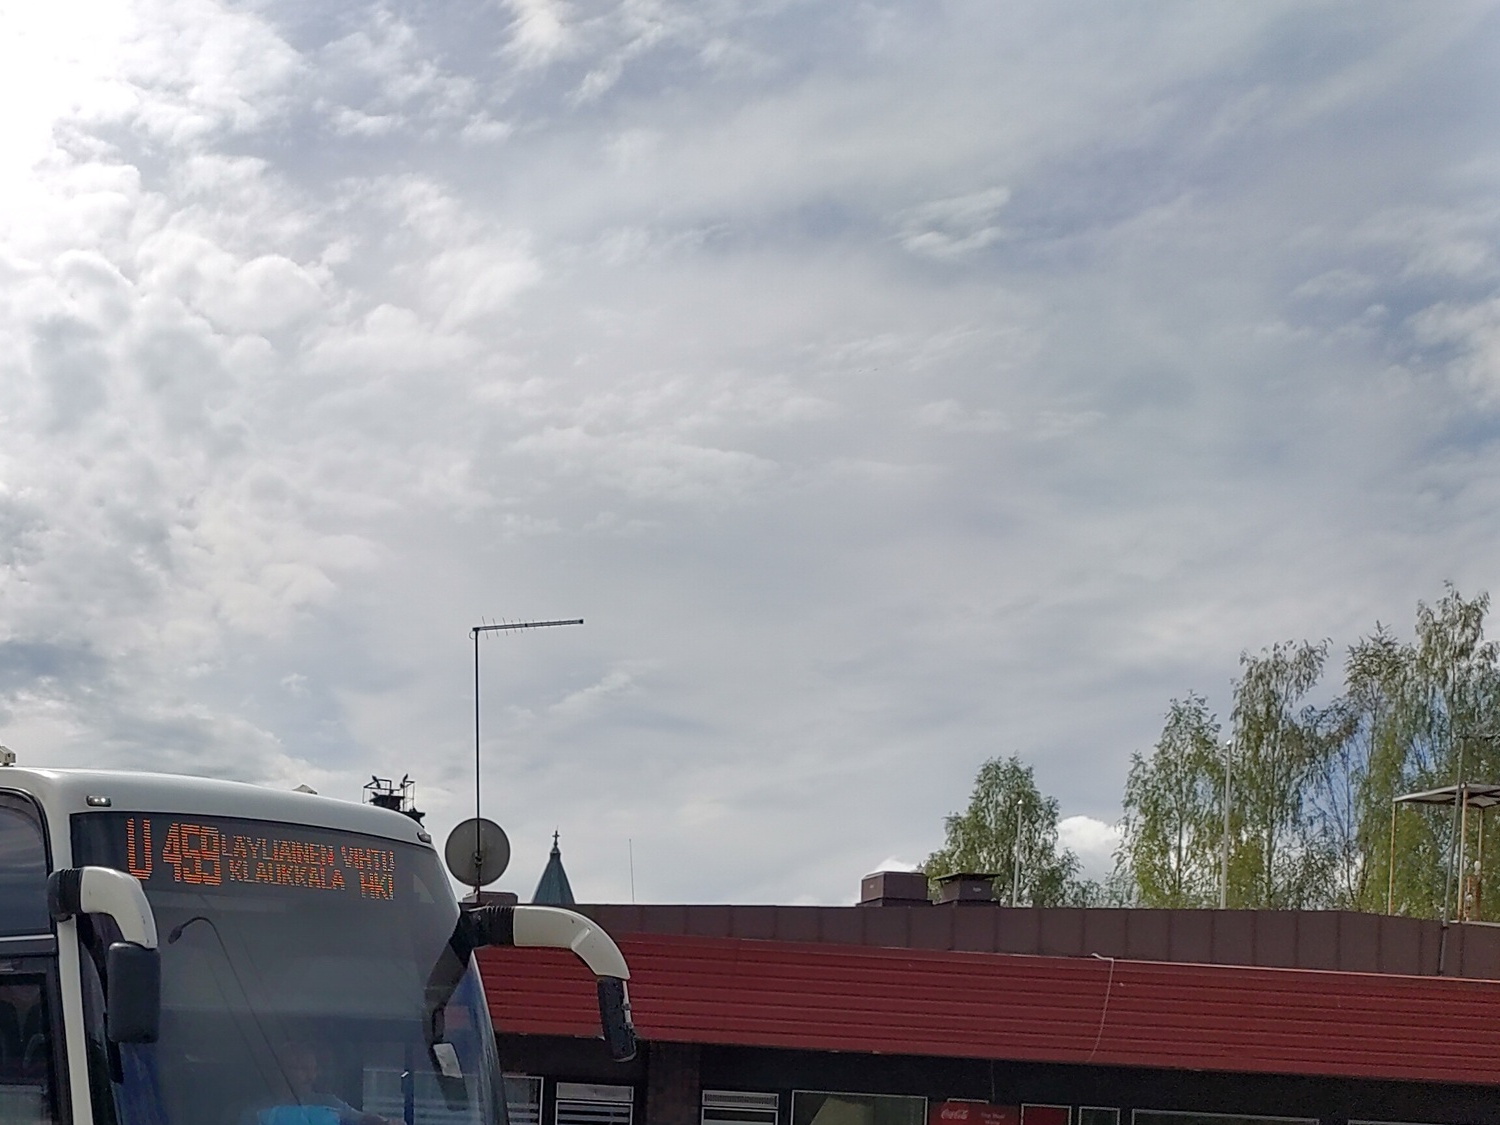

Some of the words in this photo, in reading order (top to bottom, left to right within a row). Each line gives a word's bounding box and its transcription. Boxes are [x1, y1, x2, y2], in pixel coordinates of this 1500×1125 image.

[126, 817, 153, 880] U
[162, 822, 223, 886] 459
[340, 844, 397, 873] VIHTI
[229, 858, 346, 891] KLAUKKALA
[359, 870, 395, 901] HKI
